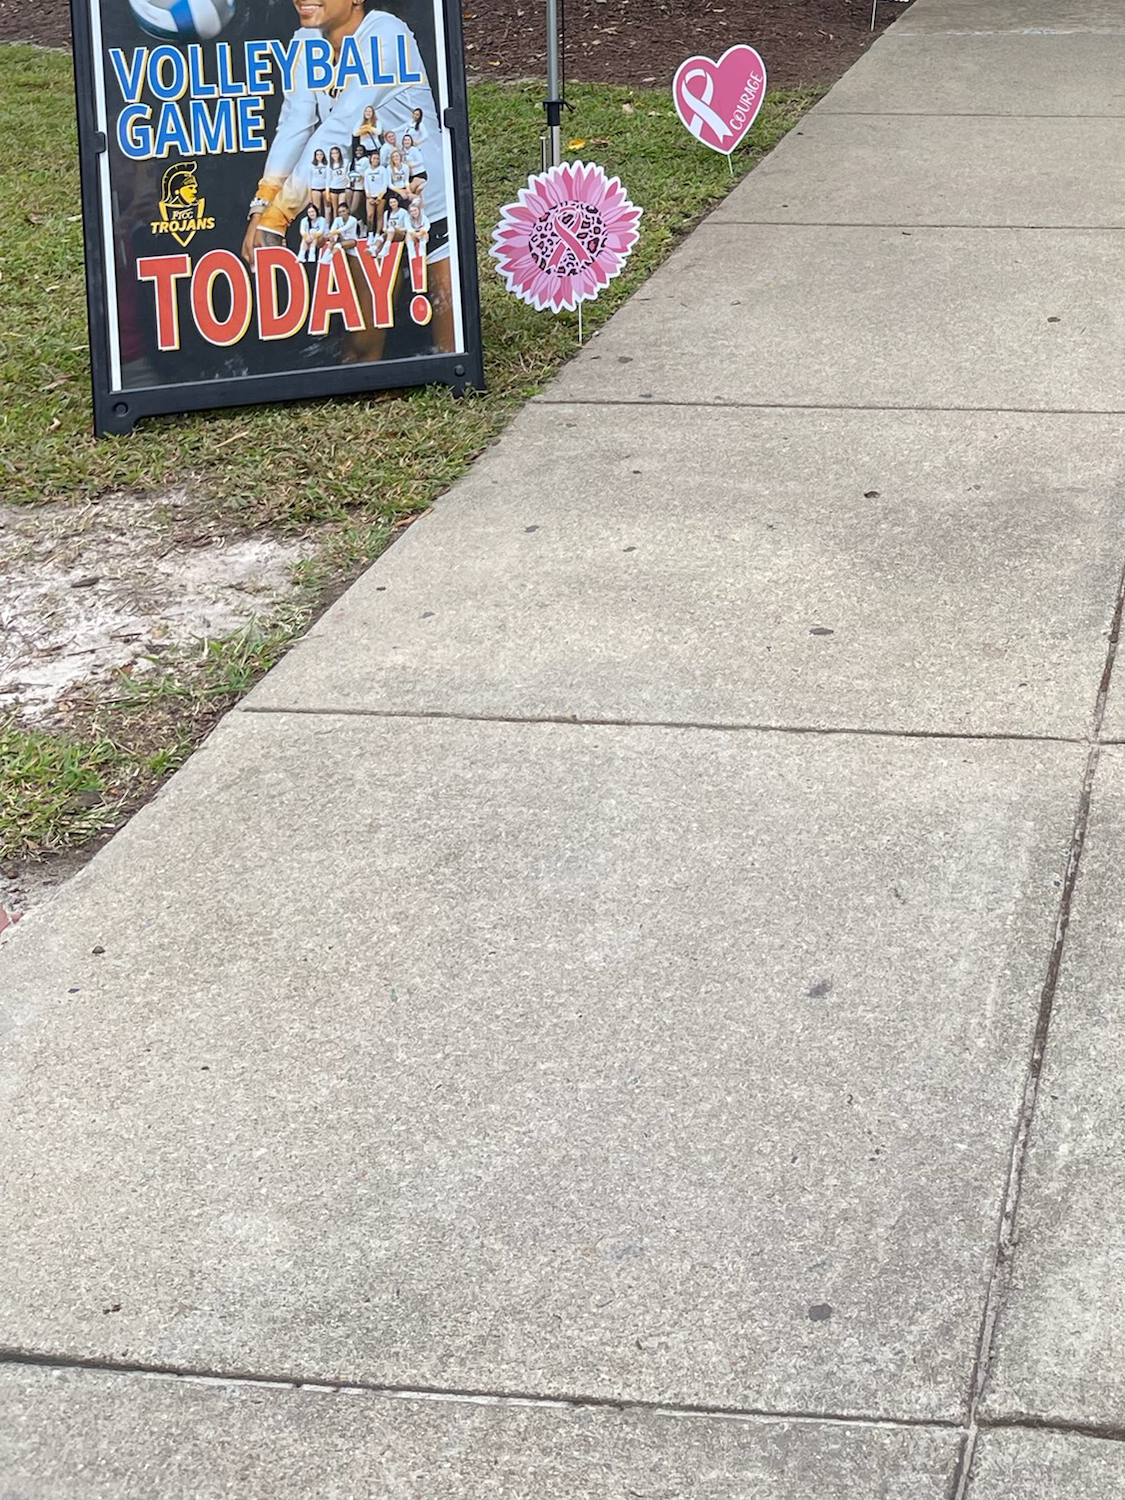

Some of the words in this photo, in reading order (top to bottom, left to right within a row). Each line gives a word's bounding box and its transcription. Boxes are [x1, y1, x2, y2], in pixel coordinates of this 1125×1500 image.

[109, 34, 423, 102] VOLLEYBALL
[118, 96, 267, 160] GAME
[729, 70, 763, 131] COURAGE
[150, 217, 216, 235] TROJANS
[137, 240, 433, 352] TODAY!
